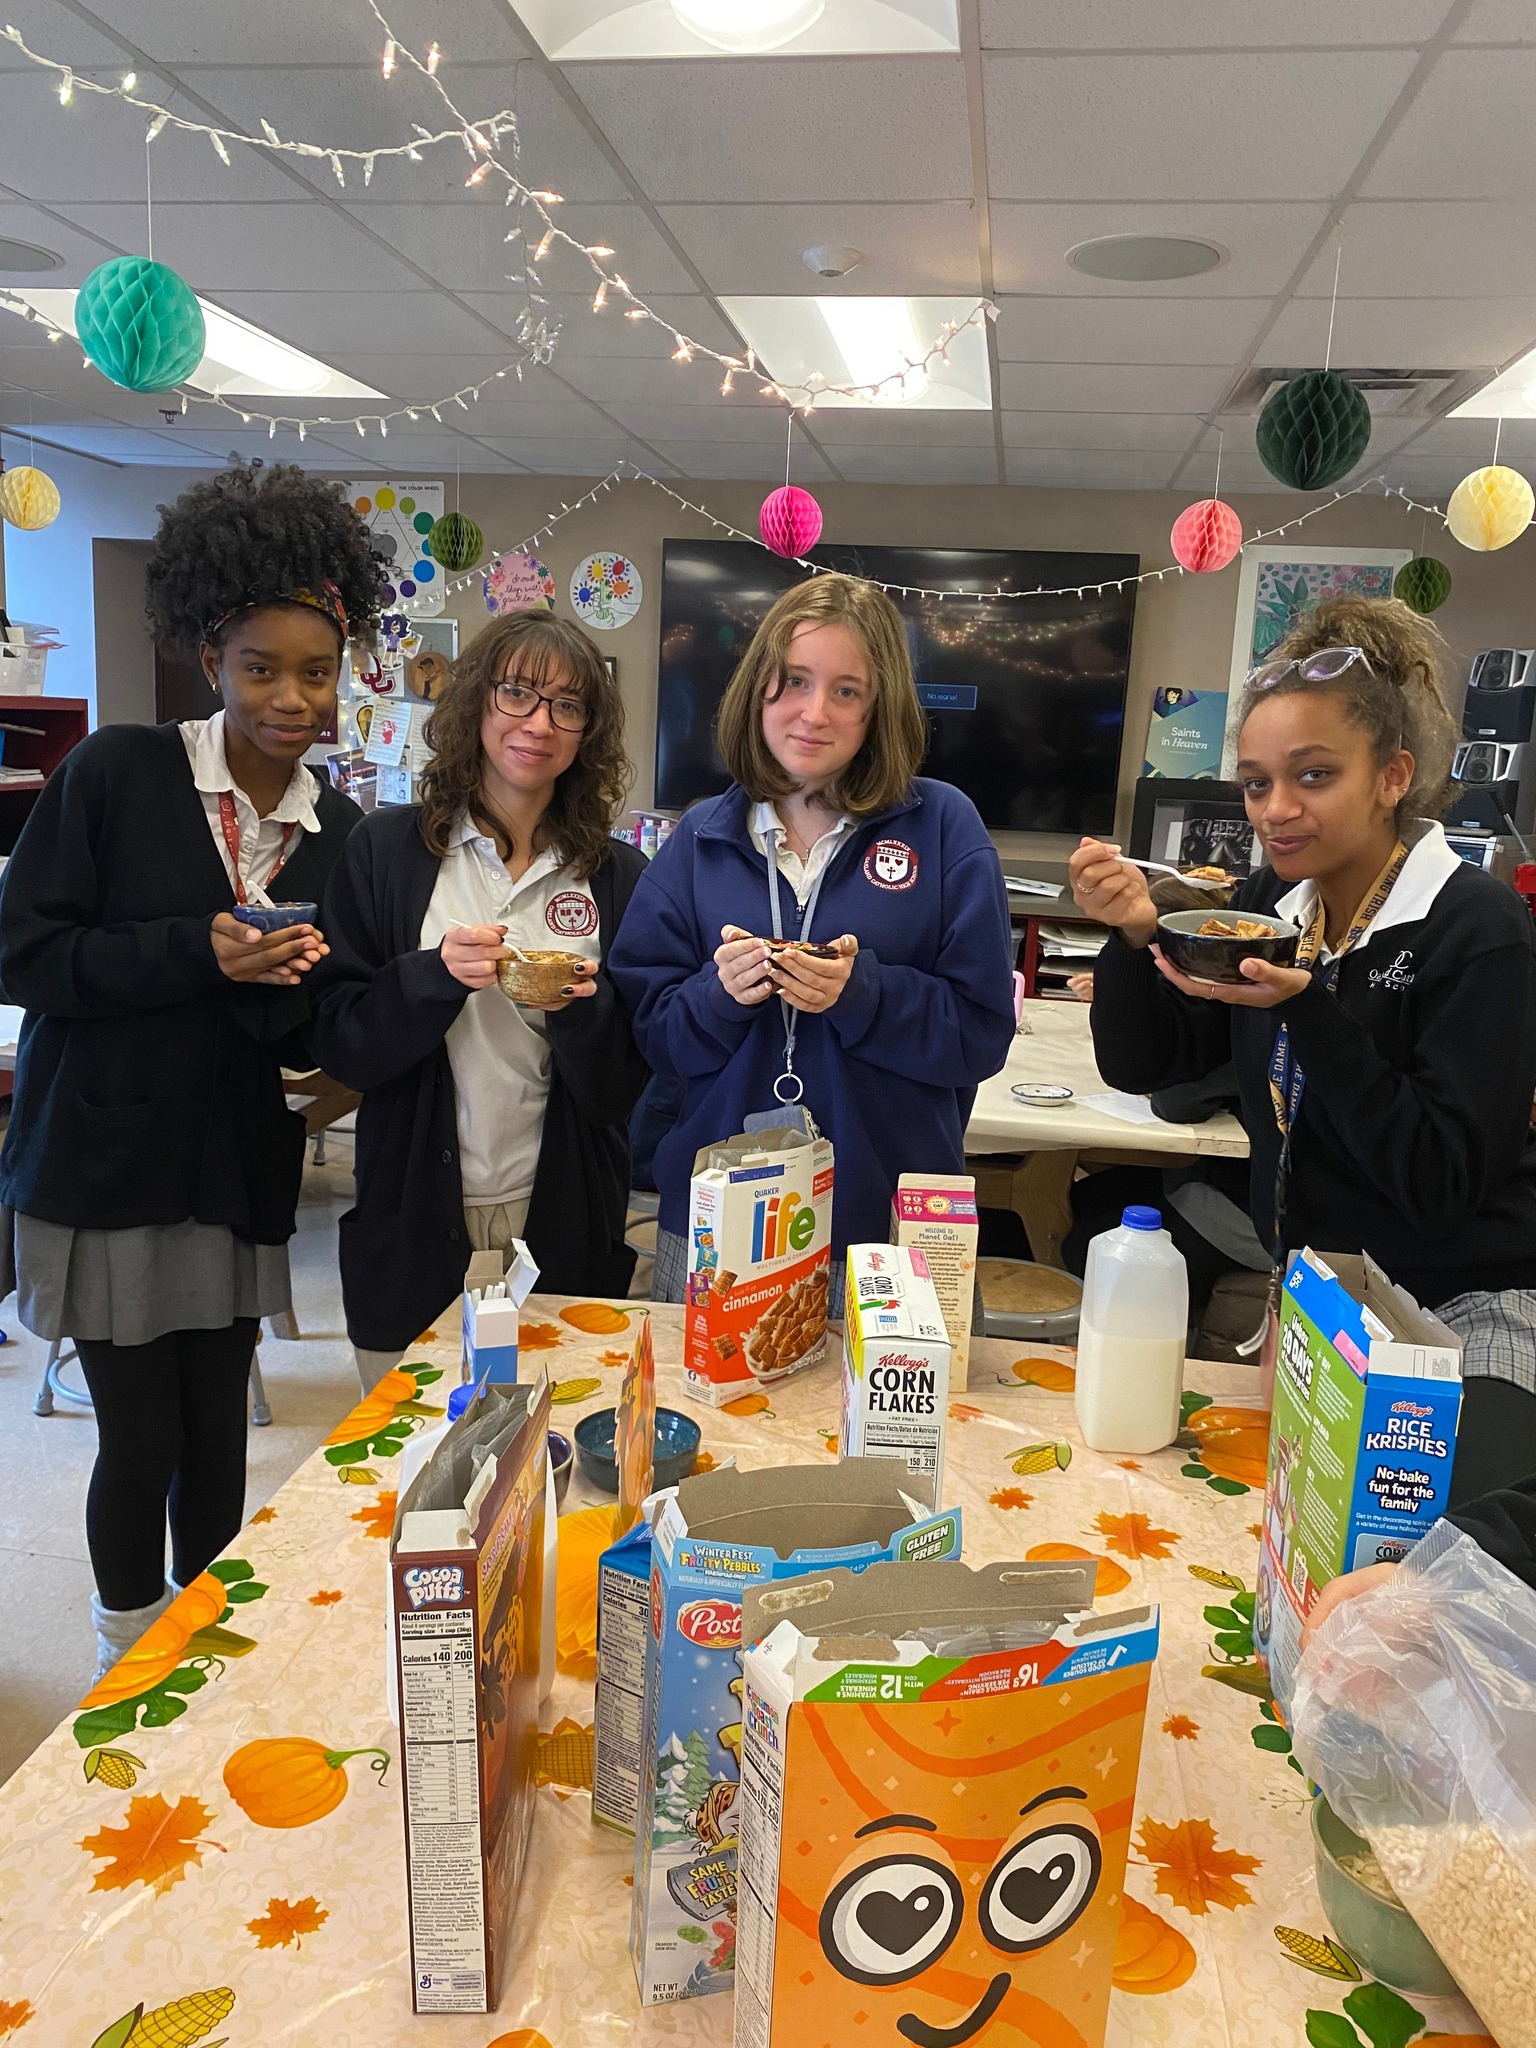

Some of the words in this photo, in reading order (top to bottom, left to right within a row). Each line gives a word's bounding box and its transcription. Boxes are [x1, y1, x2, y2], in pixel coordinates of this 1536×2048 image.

[1171, 726, 1201, 739] Saints
[1161, 736, 1170, 746] in
[1172, 737, 1208, 750] Heaven
[1360, 893, 1387, 921] IRISH
[754, 1187, 780, 1198] QUAKER
[751, 1191, 816, 1264] life
[756, 1255, 792, 1270] MULTIGRAIN
[792, 1250, 810, 1260] CEREAL
[874, 1276, 894, 1295] CORN
[722, 1283, 783, 1313] cinnamon
[878, 1352, 930, 1371] Kellogg's
[1291, 1338, 1314, 1386] DAYS
[869, 1367, 935, 1394] CORN
[869, 1392, 936, 1415] FLAKES
[1391, 1401, 1434, 1417] Kellogg's
[867, 1423, 886, 1431] Nutrition
[1387, 1417, 1433, 1438] RICE
[1366, 1433, 1447, 1458] KRISPIES
[909, 1457, 921, 1466] 150
[924, 1458, 936, 1467] 210
[1376, 1466, 1430, 1485] No-bake
[1368, 1480, 1390, 1494] fun
[1392, 1483, 1411, 1496] for
[1413, 1486, 1434, 1499] the
[1380, 1496, 1419, 1513] family
[1382, 1516, 1411, 1526] decorating
[1399, 1525, 1419, 1534] holiday
[906, 1524, 949, 1553] GLUTEN
[911, 1541, 942, 1562] FREE
[722, 1557, 762, 1574] PEBBLES
[405, 1567, 462, 1589] Cocoa
[604, 1568, 631, 1584] Nutrition
[632, 1578, 650, 1591] Facts
[603, 1594, 627, 1610] Calories
[638, 1606, 649, 1618] 30
[401, 1613, 442, 1621] Nutrition
[446, 1611, 471, 1619] Facts
[690, 1607, 742, 1637] Post
[403, 1655, 432, 1663] Calories
[433, 1651, 451, 1662] 140
[454, 1650, 473, 1661] 200
[1063, 1668, 1087, 1679] SOURCE
[1070, 1661, 1098, 1672] CALCIUM
[1087, 1663, 1106, 1673] GOOD
[880, 1674, 904, 1699] 12
[968, 1680, 999, 1691] SERVING
[986, 1684, 1010, 1694] WHOLE
[748, 1709, 779, 1751] Crunch
[766, 1754, 781, 1777] Facts
[689, 1860, 728, 1881] SAME
[652, 1993, 664, 2001] 9.5
[665, 1991, 675, 2000] OZ
[653, 1983, 667, 1992] NET
[667, 1982, 679, 1991] WT
